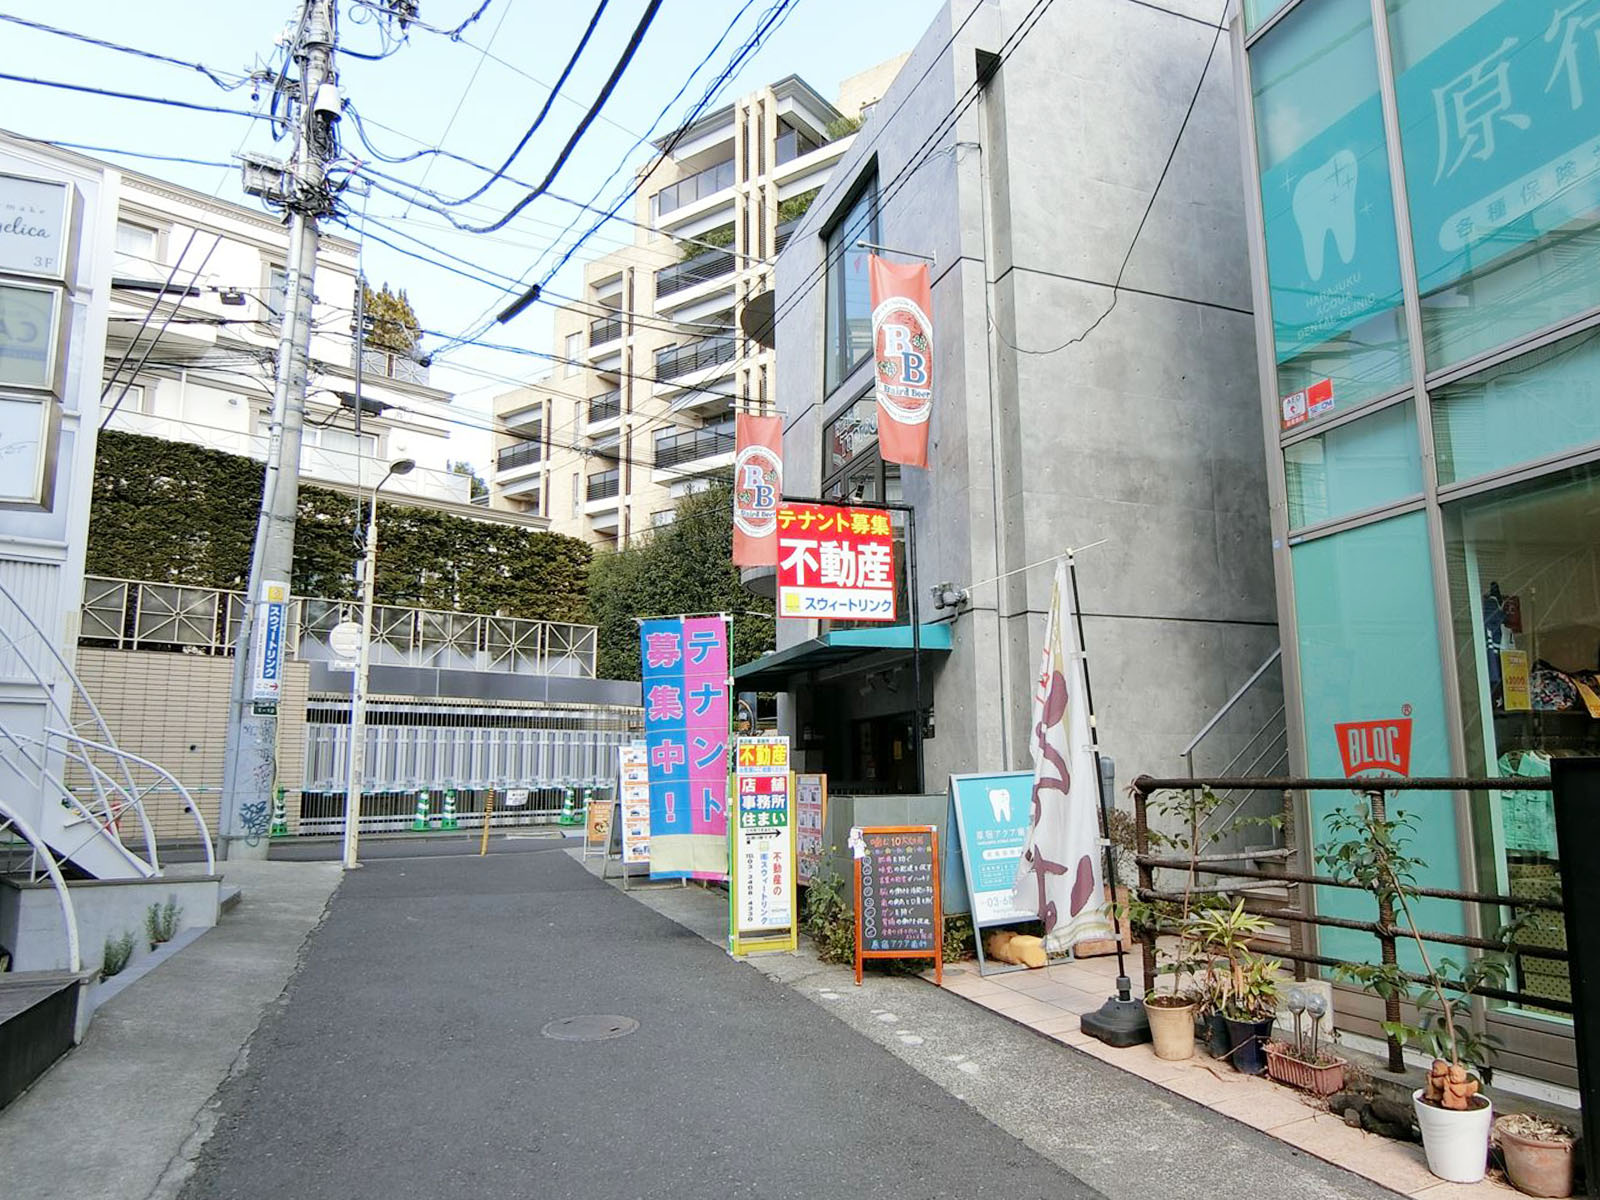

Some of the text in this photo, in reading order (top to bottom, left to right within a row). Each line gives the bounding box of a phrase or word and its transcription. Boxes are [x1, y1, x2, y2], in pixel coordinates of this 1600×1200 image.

[0, 216, 51, 238] elica
[33, 256, 54, 268] 3F
[778, 511, 890, 535] テナント募集
[780, 538, 893, 588] 不動産
[805, 597, 892, 612] スウィートリンク
[264, 605, 280, 678] スウィートリンク
[687, 631, 724, 823] テナント
[740, 745, 787, 766] 不動産
[1347, 727, 1401, 768] BLOC
[742, 795, 785, 809] 事務所
[742, 812, 786, 827] 住まい
[976, 828, 1025, 841] 原宿アクア歯
[773, 852, 782, 896] 不動産の
